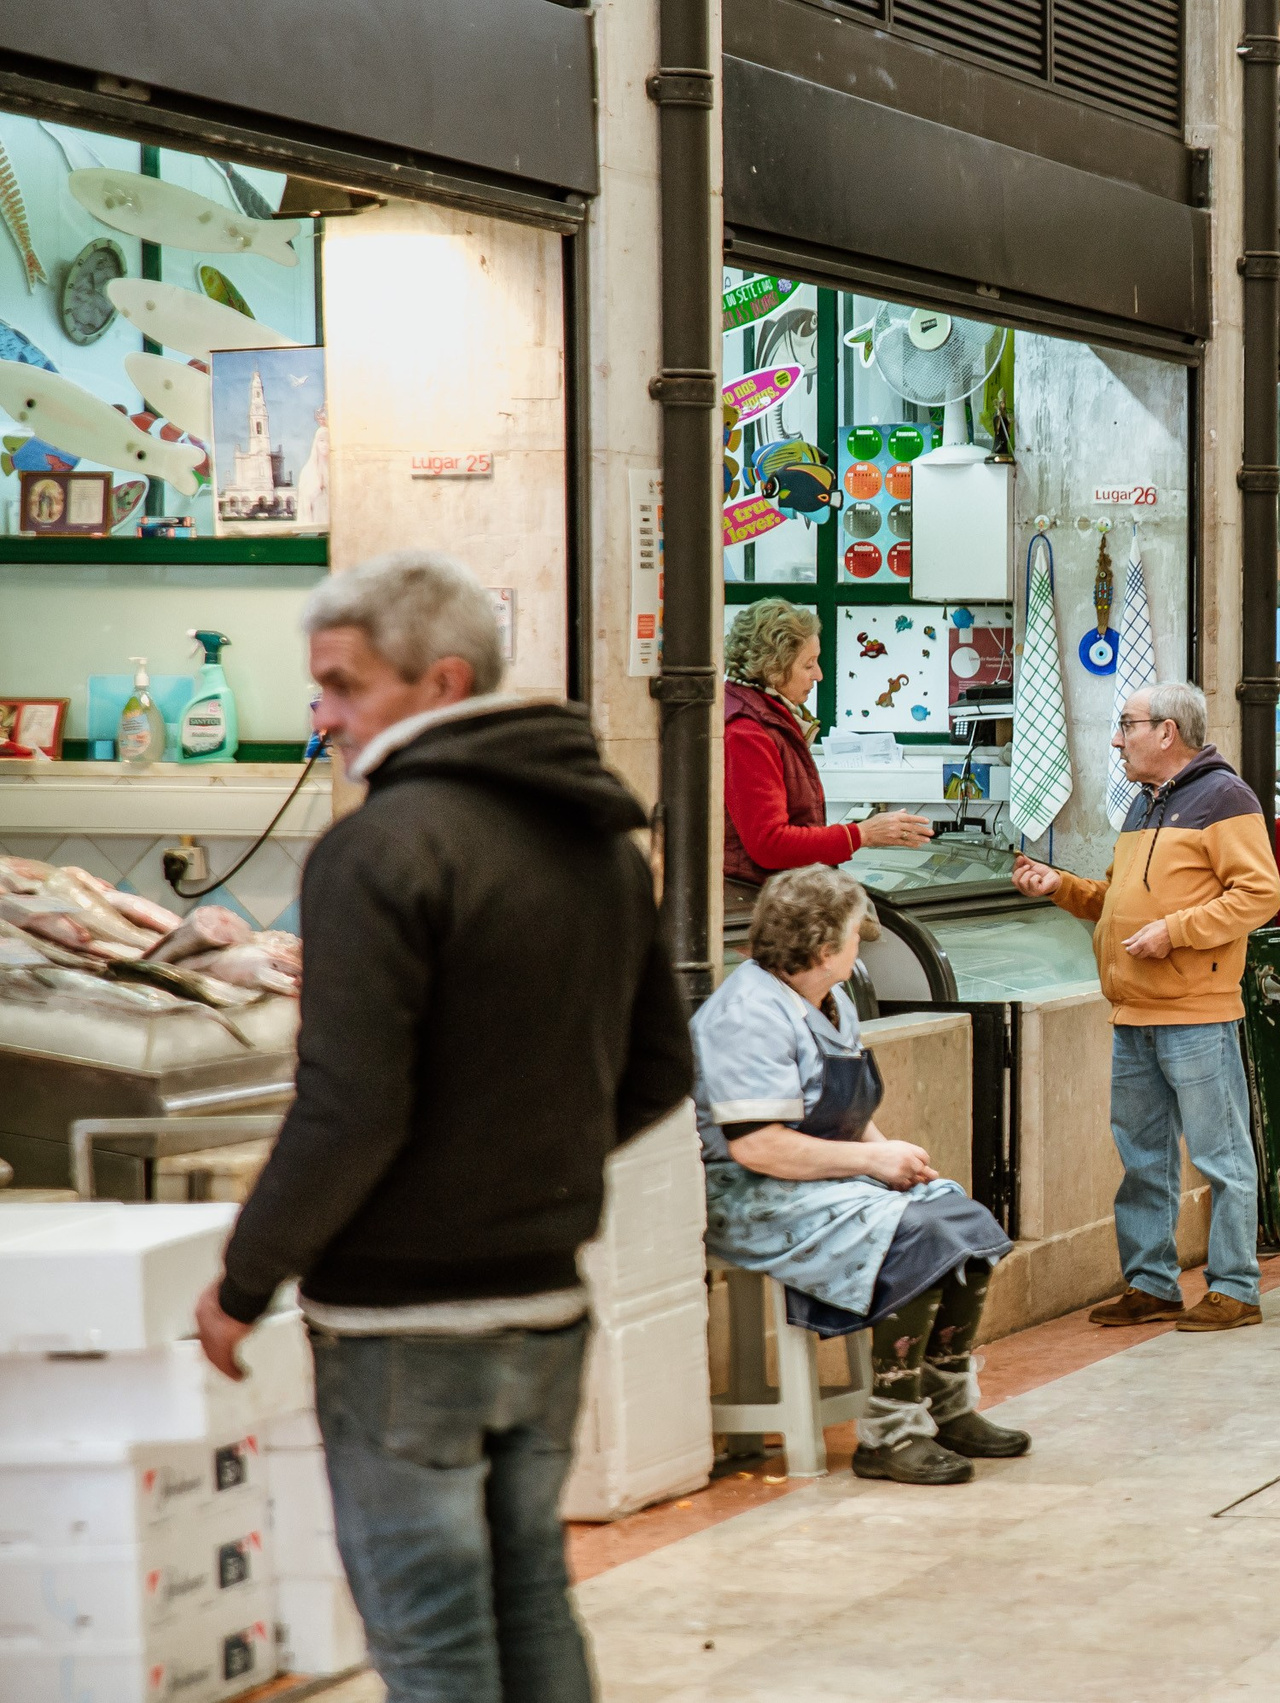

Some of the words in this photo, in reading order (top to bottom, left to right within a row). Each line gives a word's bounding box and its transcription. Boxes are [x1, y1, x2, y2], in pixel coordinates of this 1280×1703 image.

[736, 283, 757, 304] SETE
[412, 456, 461, 475] Lugar
[466, 454, 491, 472] 25
[1095, 489, 1133, 503] Lugar
[1133, 486, 1157, 505] 26
[727, 513, 780, 543] lover.
